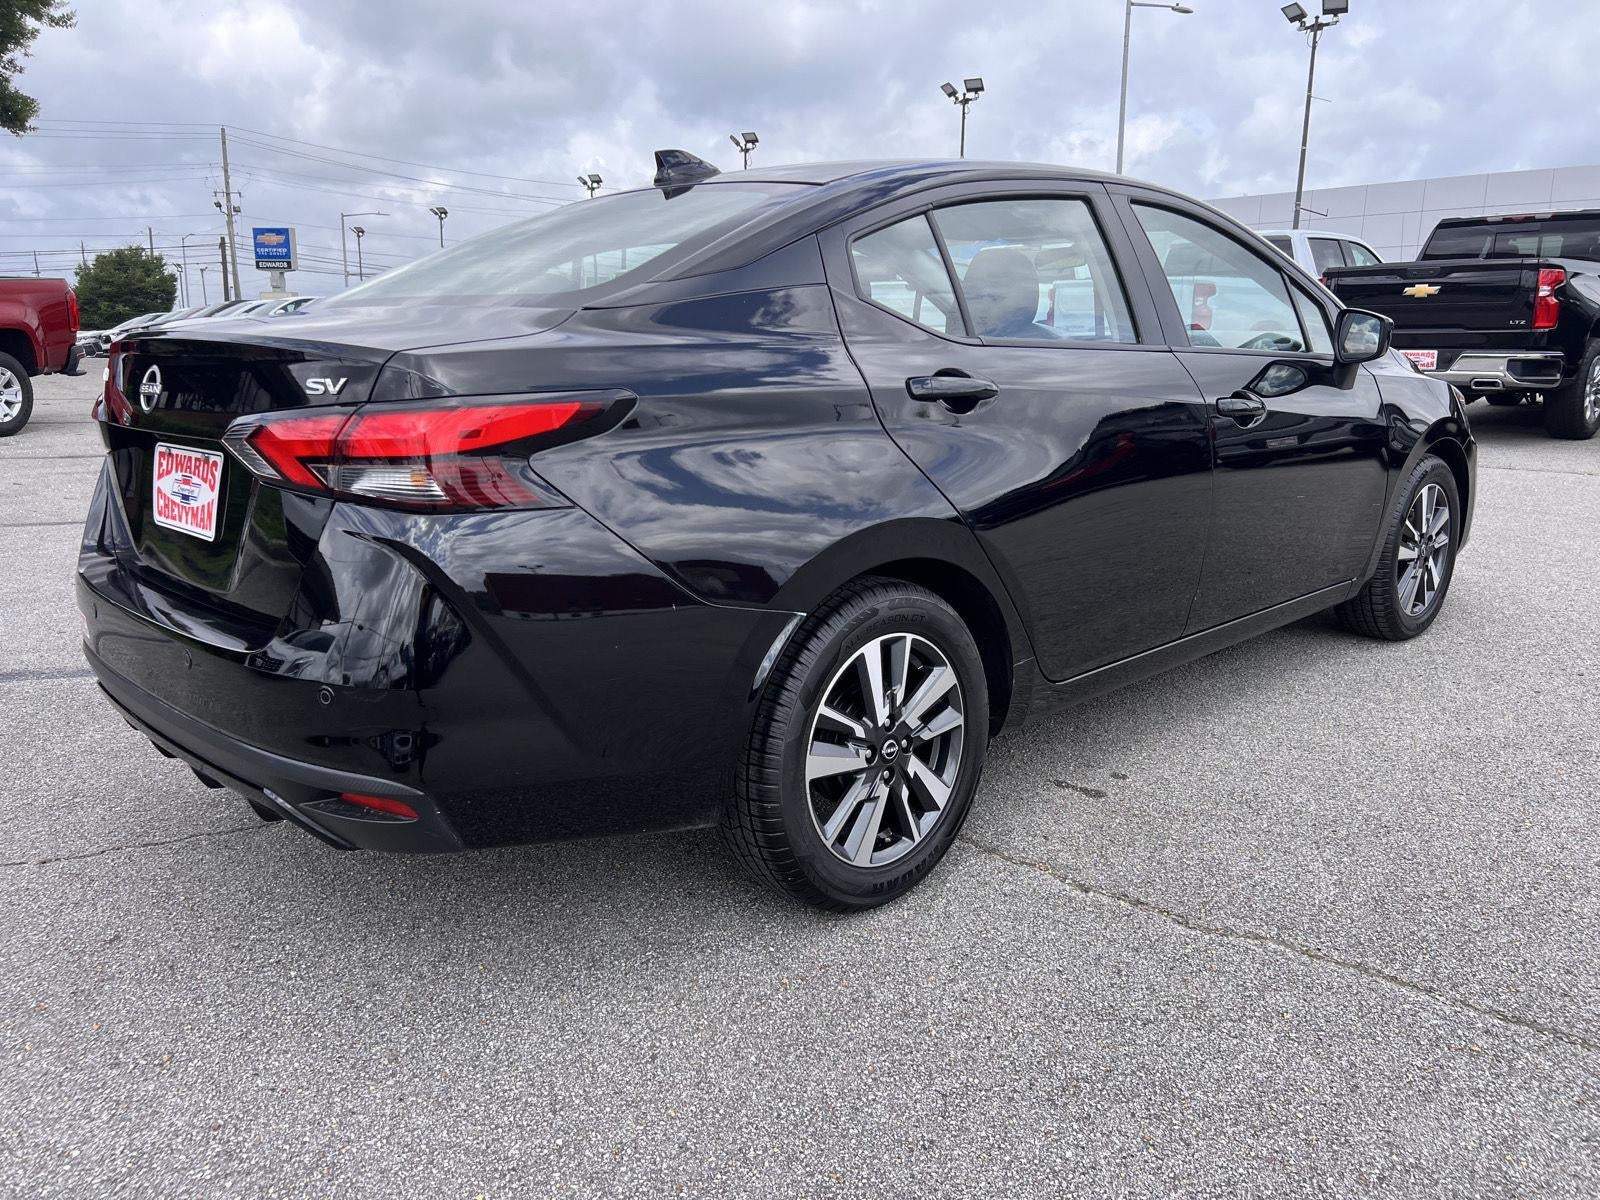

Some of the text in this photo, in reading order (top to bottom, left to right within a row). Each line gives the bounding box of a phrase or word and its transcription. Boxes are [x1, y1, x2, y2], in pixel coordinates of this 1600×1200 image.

[305, 377, 348, 395] SV
[157, 450, 219, 493] EDWARDS
[157, 486, 215, 532] CHEVYMAN
